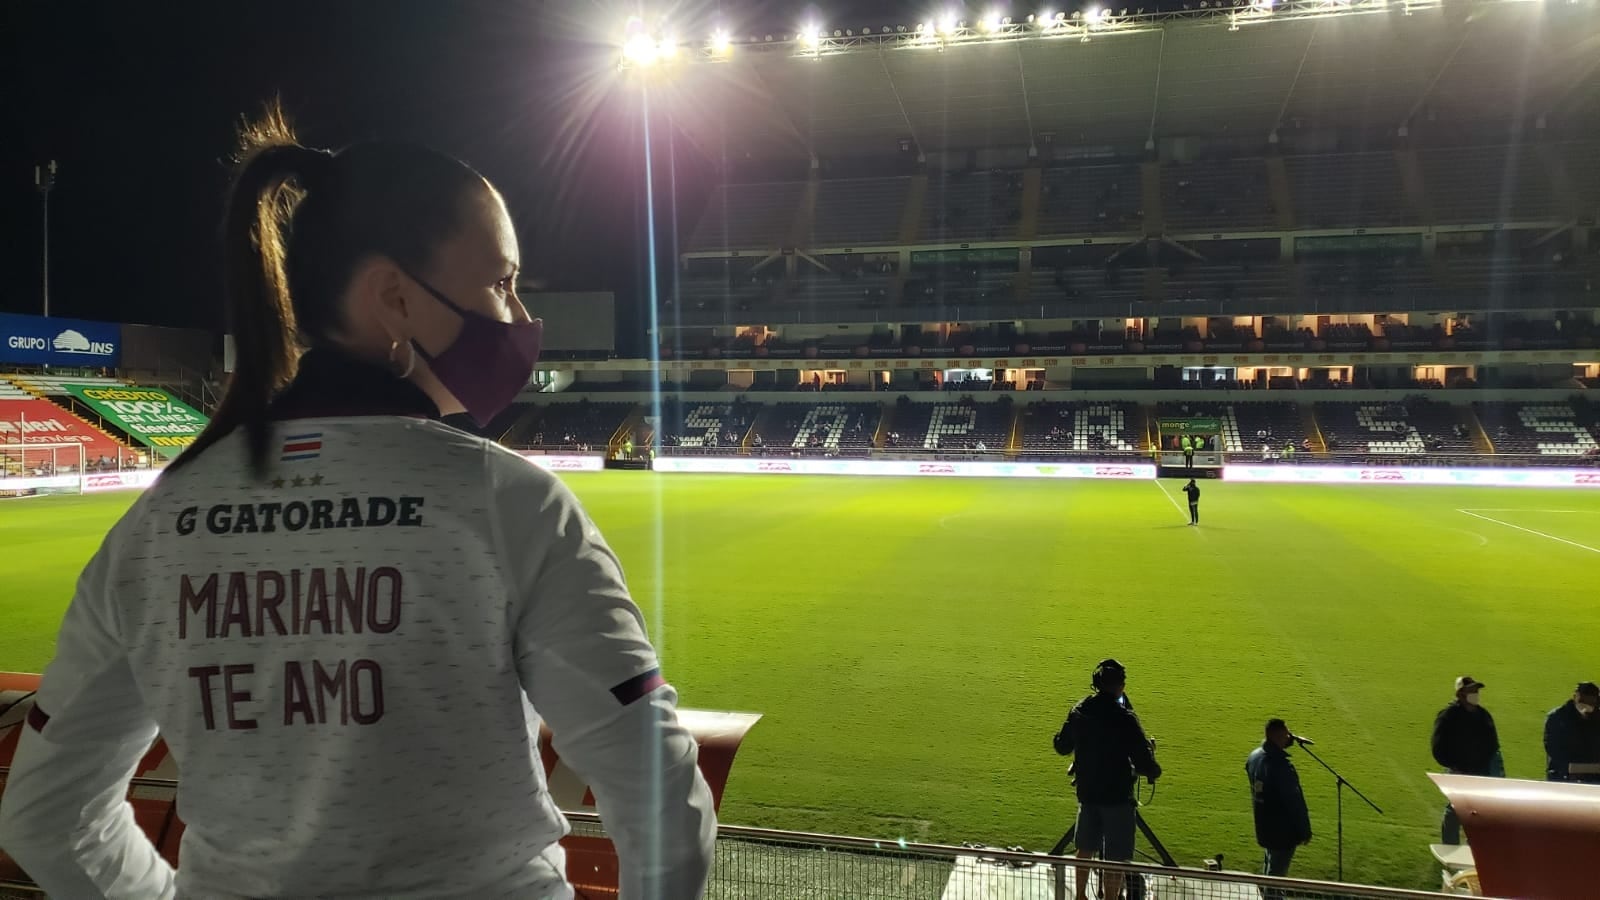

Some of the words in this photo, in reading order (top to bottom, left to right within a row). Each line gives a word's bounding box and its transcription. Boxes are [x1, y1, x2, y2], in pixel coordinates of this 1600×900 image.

[8, 336, 45, 350] GRUPO
[90, 342, 114, 355] INS
[82, 388, 168, 401] CRÉDITO
[100, 400, 187, 415] 100%
[118, 414, 145, 423] EN
[145, 412, 200, 423] LÍNEA
[129, 423, 193, 434] tienda
[1161, 421, 1190, 430] monge
[148, 436, 198, 447] mon
[175, 505, 199, 536] G
[206, 496, 425, 535] GATORADE
[178, 566, 403, 640] MARIANO
[188, 664, 258, 730] TE
[283, 659, 386, 727] AMO
